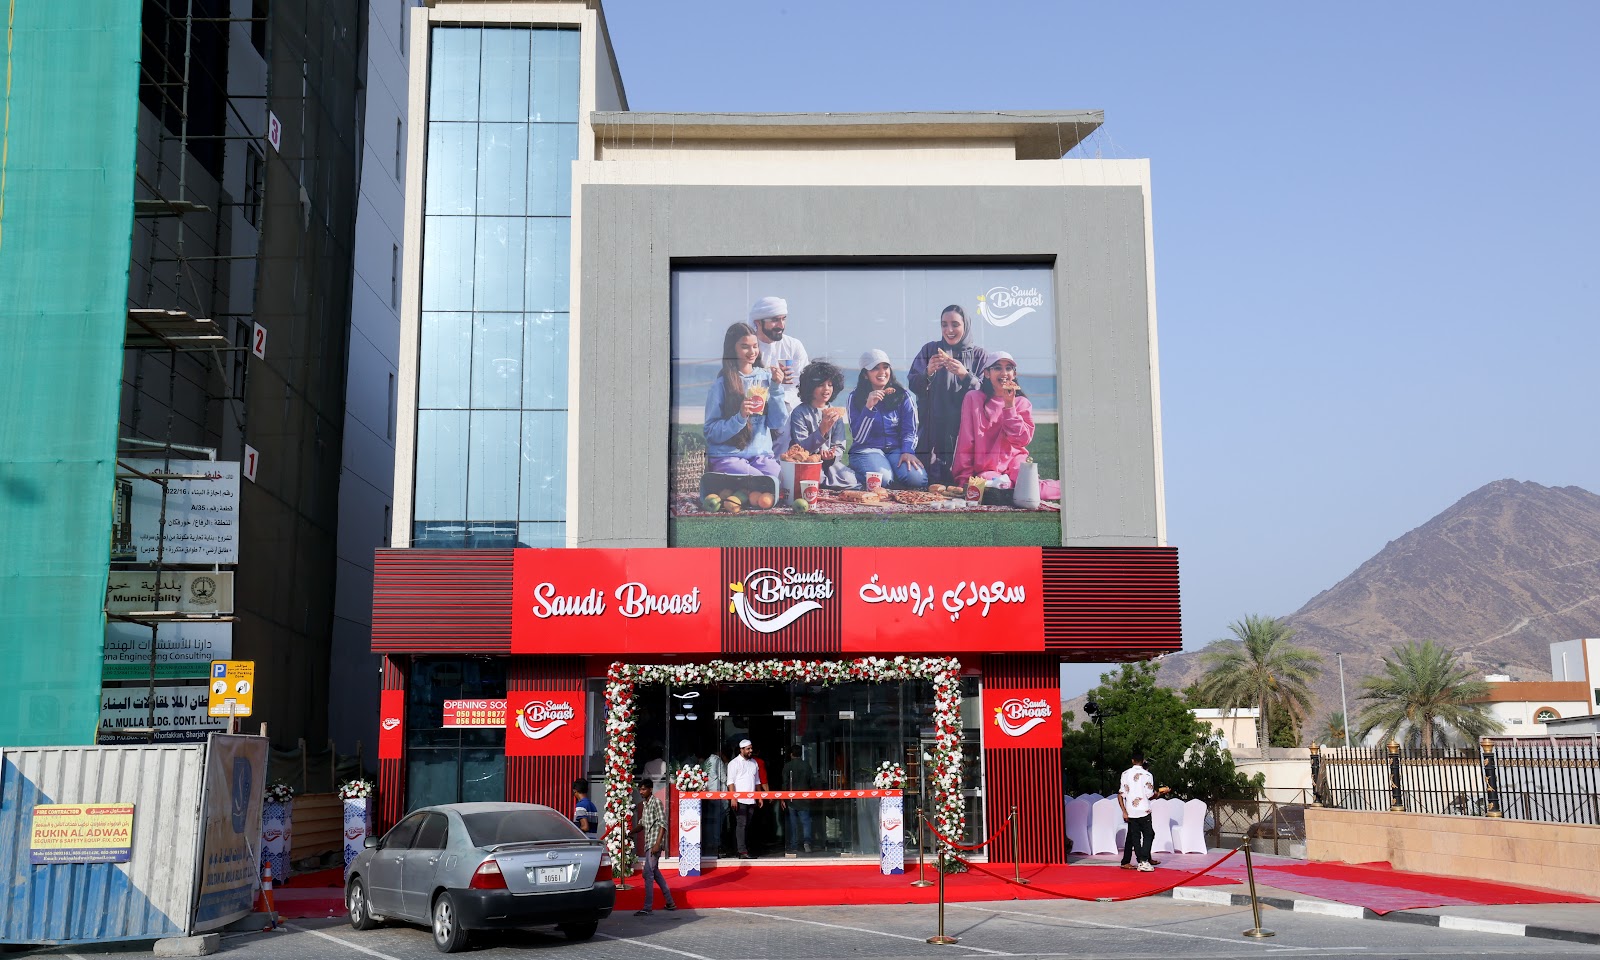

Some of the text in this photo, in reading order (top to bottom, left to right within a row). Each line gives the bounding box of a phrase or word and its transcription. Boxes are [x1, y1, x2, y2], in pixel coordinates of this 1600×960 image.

[272, 118, 279, 145] 3
[1010, 285, 1038, 297] Saudi
[990, 291, 1044, 309] Broast
[256, 328, 264, 354] 2
[249, 453, 255, 477] 1
[207, 489, 222, 498] إجازة
[223, 489, 234, 498] رقم
[209, 505, 219, 513] رقم
[781, 566, 826, 586] Saudi
[141, 579, 182, 592] بلدية
[750, 575, 835, 604] Broast
[113, 594, 182, 603] Municipality
[532, 581, 702, 619] Saudi Broast
[858, 572, 1026, 623] سعودي بروست
[169, 652, 212, 662] Consulting
[214, 664, 225, 678] P
[443, 701, 487, 709] OPENING
[545, 699, 570, 711] Saudi
[1023, 697, 1047, 710] Saudi
[456, 710, 470, 718] 050
[526, 705, 575, 722] Broast
[1004, 703, 1052, 720] Broast
[102, 718, 114, 728] AL
[115, 717, 144, 728] MULLA
[173, 716, 197, 726] CONT.
[185, 731, 206, 739] Sharjah
[34, 828, 129, 838] RUKIN AL ADWAA
